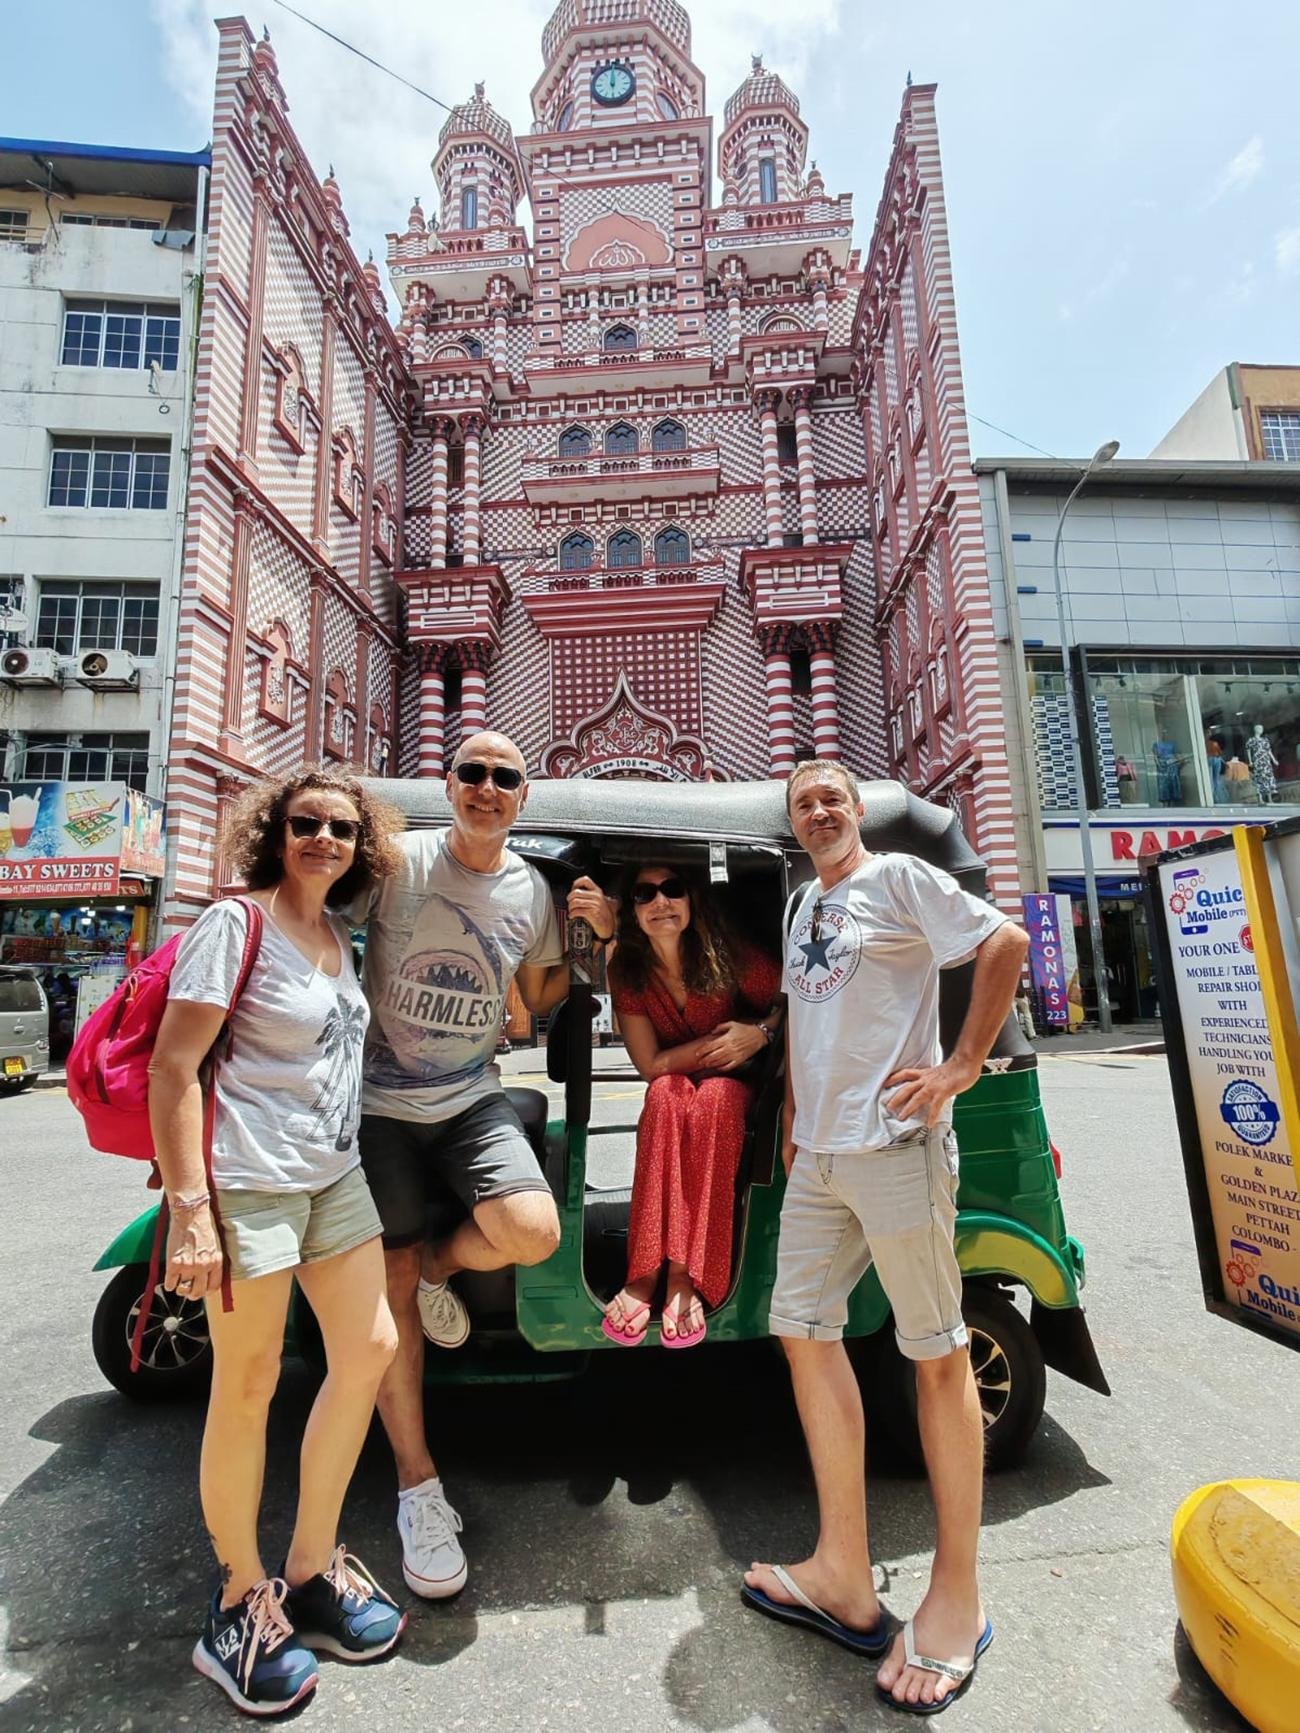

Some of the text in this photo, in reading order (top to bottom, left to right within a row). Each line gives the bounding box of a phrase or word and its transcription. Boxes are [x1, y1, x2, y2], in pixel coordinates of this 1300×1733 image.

[40, 863, 114, 879] SWEETS
[1197, 886, 1245, 907] Quic
[1187, 907, 1228, 923] Mobile
[794, 912, 847, 945] CONERSE
[1039, 900, 1059, 1005] RAMONAS
[1179, 944, 1211, 958] YOUR
[1213, 942, 1240, 955] ONE
[794, 966, 844, 994] ALL STAR
[1186, 966, 1225, 978] MOBILE
[1198, 983, 1233, 992] REPAIR
[1217, 1000, 1247, 1010] WITH
[1047, 1011, 1067, 1020] 223
[1198, 1047, 1252, 1060] HANDLING
[1217, 1063, 1266, 1077] JOB WITH
[1227, 1085, 1263, 1102] SATISFACTION
[1232, 1104, 1266, 1121] 100%
[1254, 1166, 1263, 1177] &
[1221, 1174, 1300, 1203] GOLDEN PLAZ
[1227, 1191, 1256, 1208] MAIN
[1246, 1213, 1290, 1235] PETTAH
[1232, 1224, 1290, 1252] COLOMBO
[1247, 1289, 1296, 1321] Mobile
